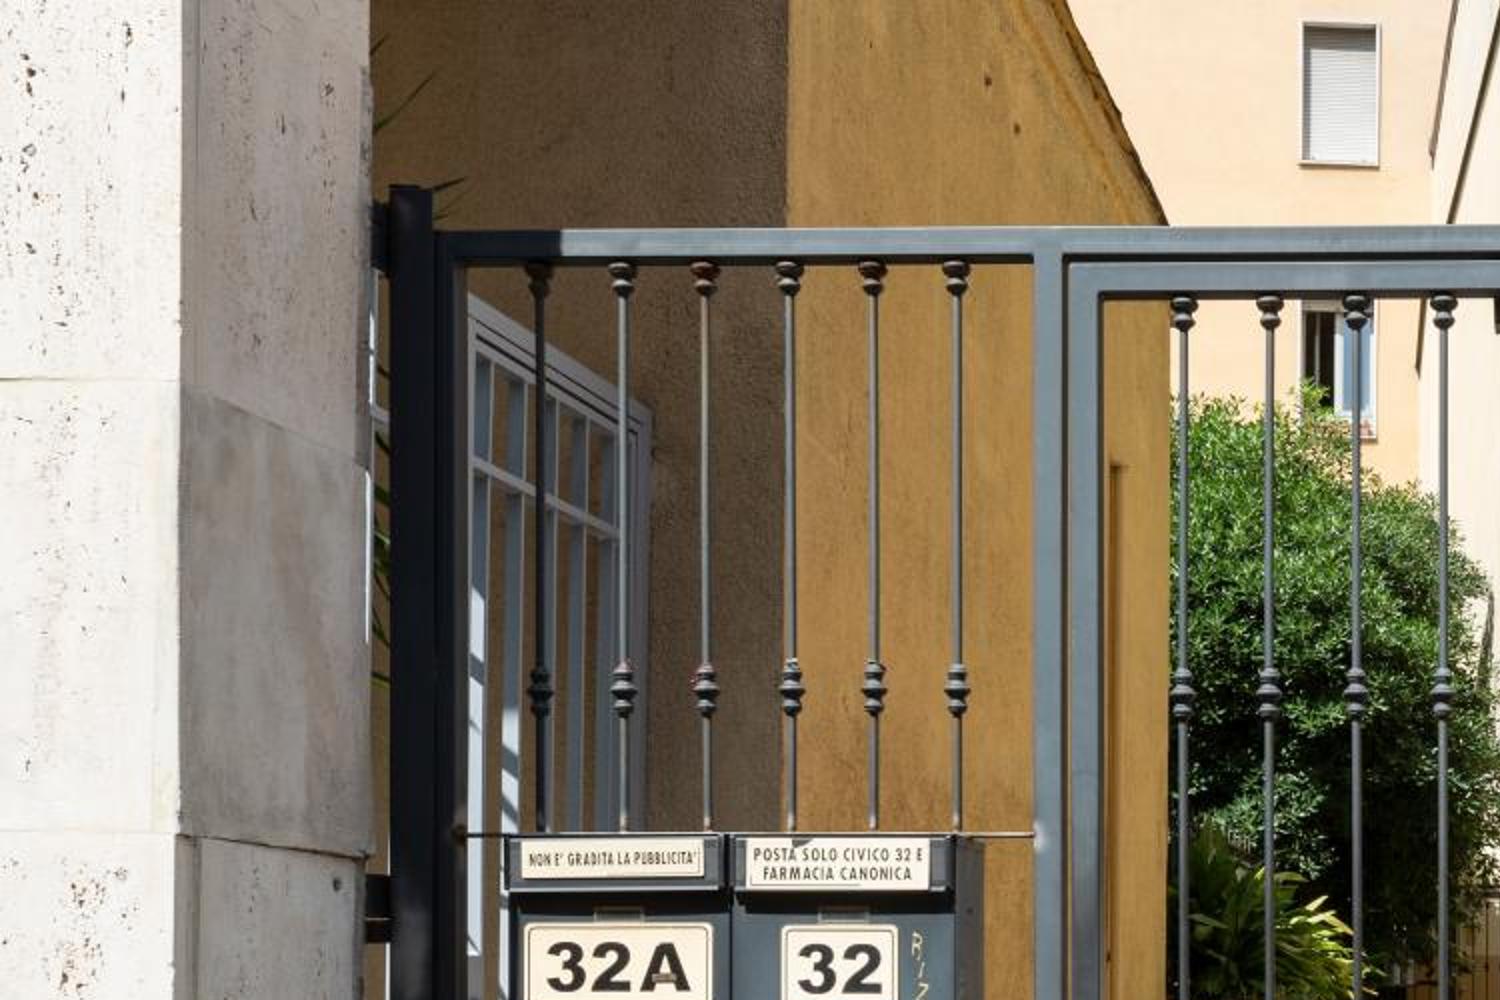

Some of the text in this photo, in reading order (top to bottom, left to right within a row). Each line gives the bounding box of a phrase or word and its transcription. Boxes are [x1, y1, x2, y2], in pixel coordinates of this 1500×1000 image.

[529, 853, 550, 866] NON
[567, 852, 614, 866] GRADITA
[617, 852, 630, 865] LA
[754, 847, 922, 861] POSTA SOLO CIVICO 32 E
[763, 867, 912, 880] FARMACIA CANONICA
[547, 941, 691, 992] 32A
[797, 943, 883, 994] 32
